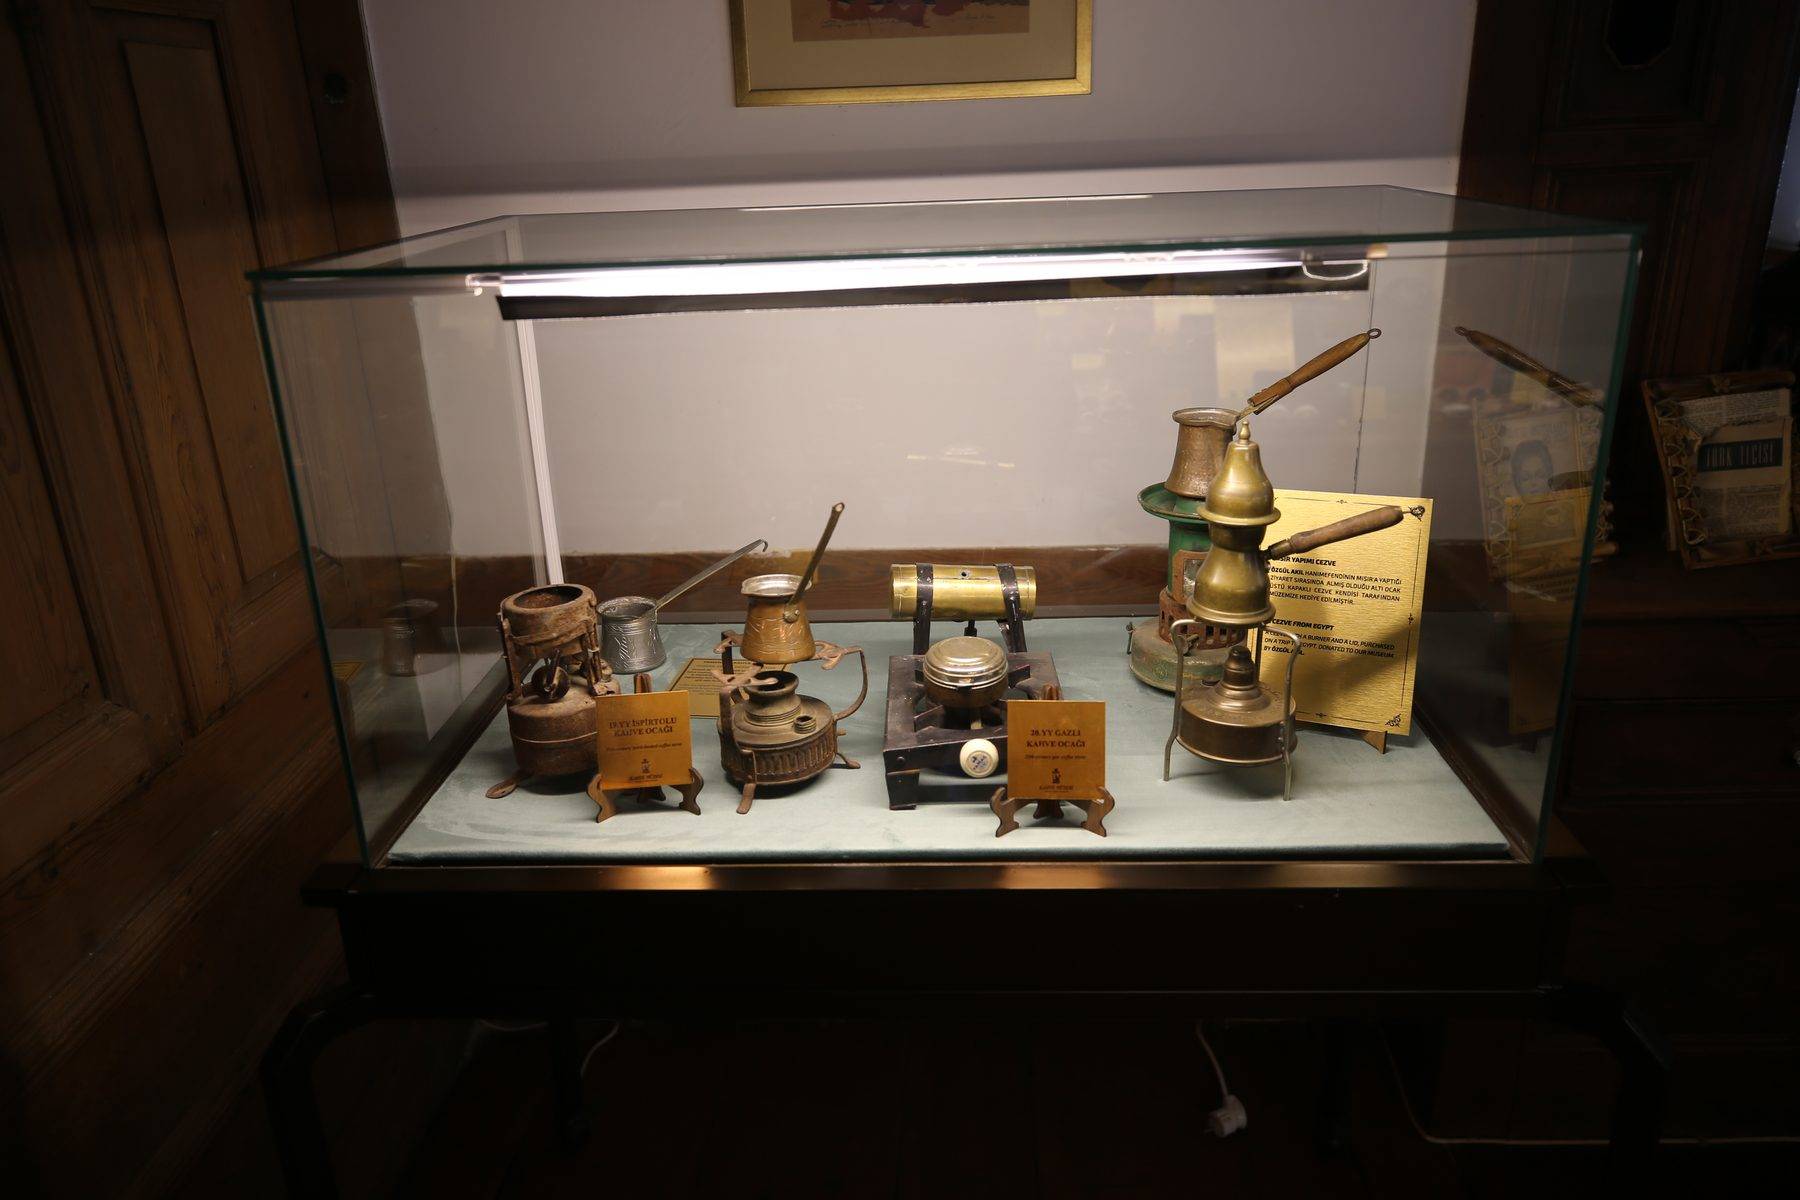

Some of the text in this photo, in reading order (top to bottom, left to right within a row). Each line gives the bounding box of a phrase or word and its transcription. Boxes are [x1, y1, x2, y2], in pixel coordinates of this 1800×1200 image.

[1291, 557, 1315, 565] YAPIMI
[1315, 559, 1337, 567] CEZVE
[1313, 587, 1333, 595] CEZVE
[1384, 586, 1401, 594] OCAK
[1272, 618, 1335, 631] CEZVE FROM EGYPT
[1307, 634, 1332, 642] BURNER
[1360, 641, 1395, 650] PURCHASED
[1354, 648, 1367, 656] OUR
[1026, 739, 1086, 748] KAHVE OCAĞI
